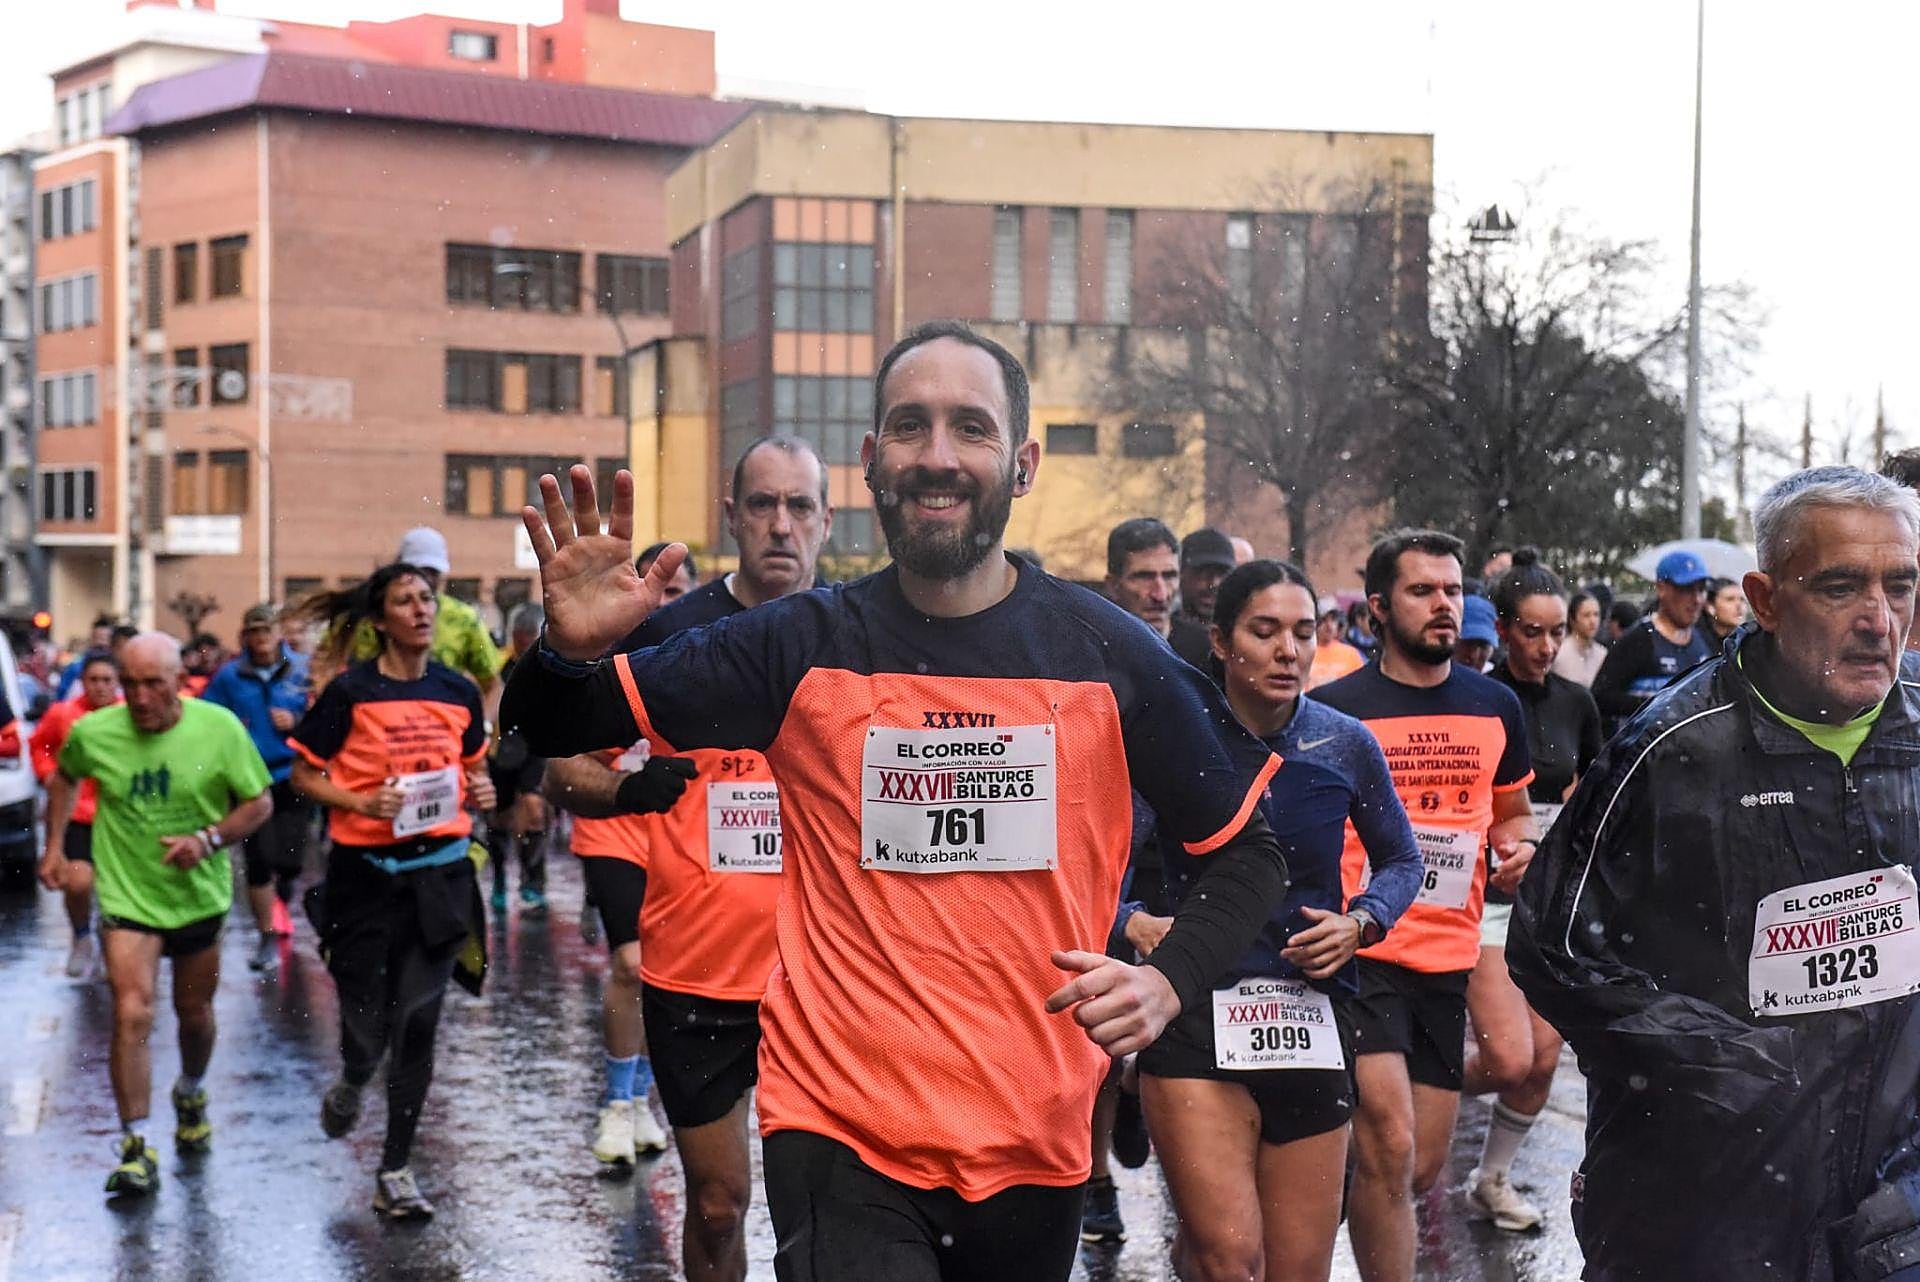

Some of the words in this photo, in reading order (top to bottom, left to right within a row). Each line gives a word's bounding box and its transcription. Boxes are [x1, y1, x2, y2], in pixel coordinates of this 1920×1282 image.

[922, 711, 996, 728] XXXVII
[1408, 733, 1449, 743] XXXVII
[897, 743, 919, 758] EL
[922, 742, 1005, 758] CORREO
[1417, 760, 1480, 770] INTERNACIONAL
[957, 770, 1034, 783] SANTURCE
[1408, 775, 1443, 786] SANTURCE
[1445, 775, 1449, 785] A
[879, 771, 952, 801] XXXVII
[957, 783, 1034, 799] BILBAO
[732, 791, 746, 800] EL
[720, 810, 768, 826] XXXVII
[926, 808, 985, 846] 761
[896, 849, 978, 864] kutxabank
[1424, 858, 1464, 868] BILBAO
[1425, 850, 1464, 860] SANTURCE
[1783, 899, 1805, 913] EL
[1808, 883, 1877, 909] CORREO
[1839, 903, 1902, 927] SANTURCE
[1766, 919, 1837, 953] XXXVII
[1839, 916, 1903, 942] BILBAO
[1802, 944, 1879, 989] 1323
[1240, 986, 1254, 996] EL
[1256, 984, 1303, 997] CORREO
[1785, 985, 1862, 1006] kutxabank
[1228, 1003, 1278, 1023] XXXVII
[1281, 1003, 1321, 1014] SANTURCE
[1281, 1010, 1323, 1023] BILBAO
[1250, 1026, 1311, 1051] 3099
[1241, 1052, 1296, 1063] kutxabank
